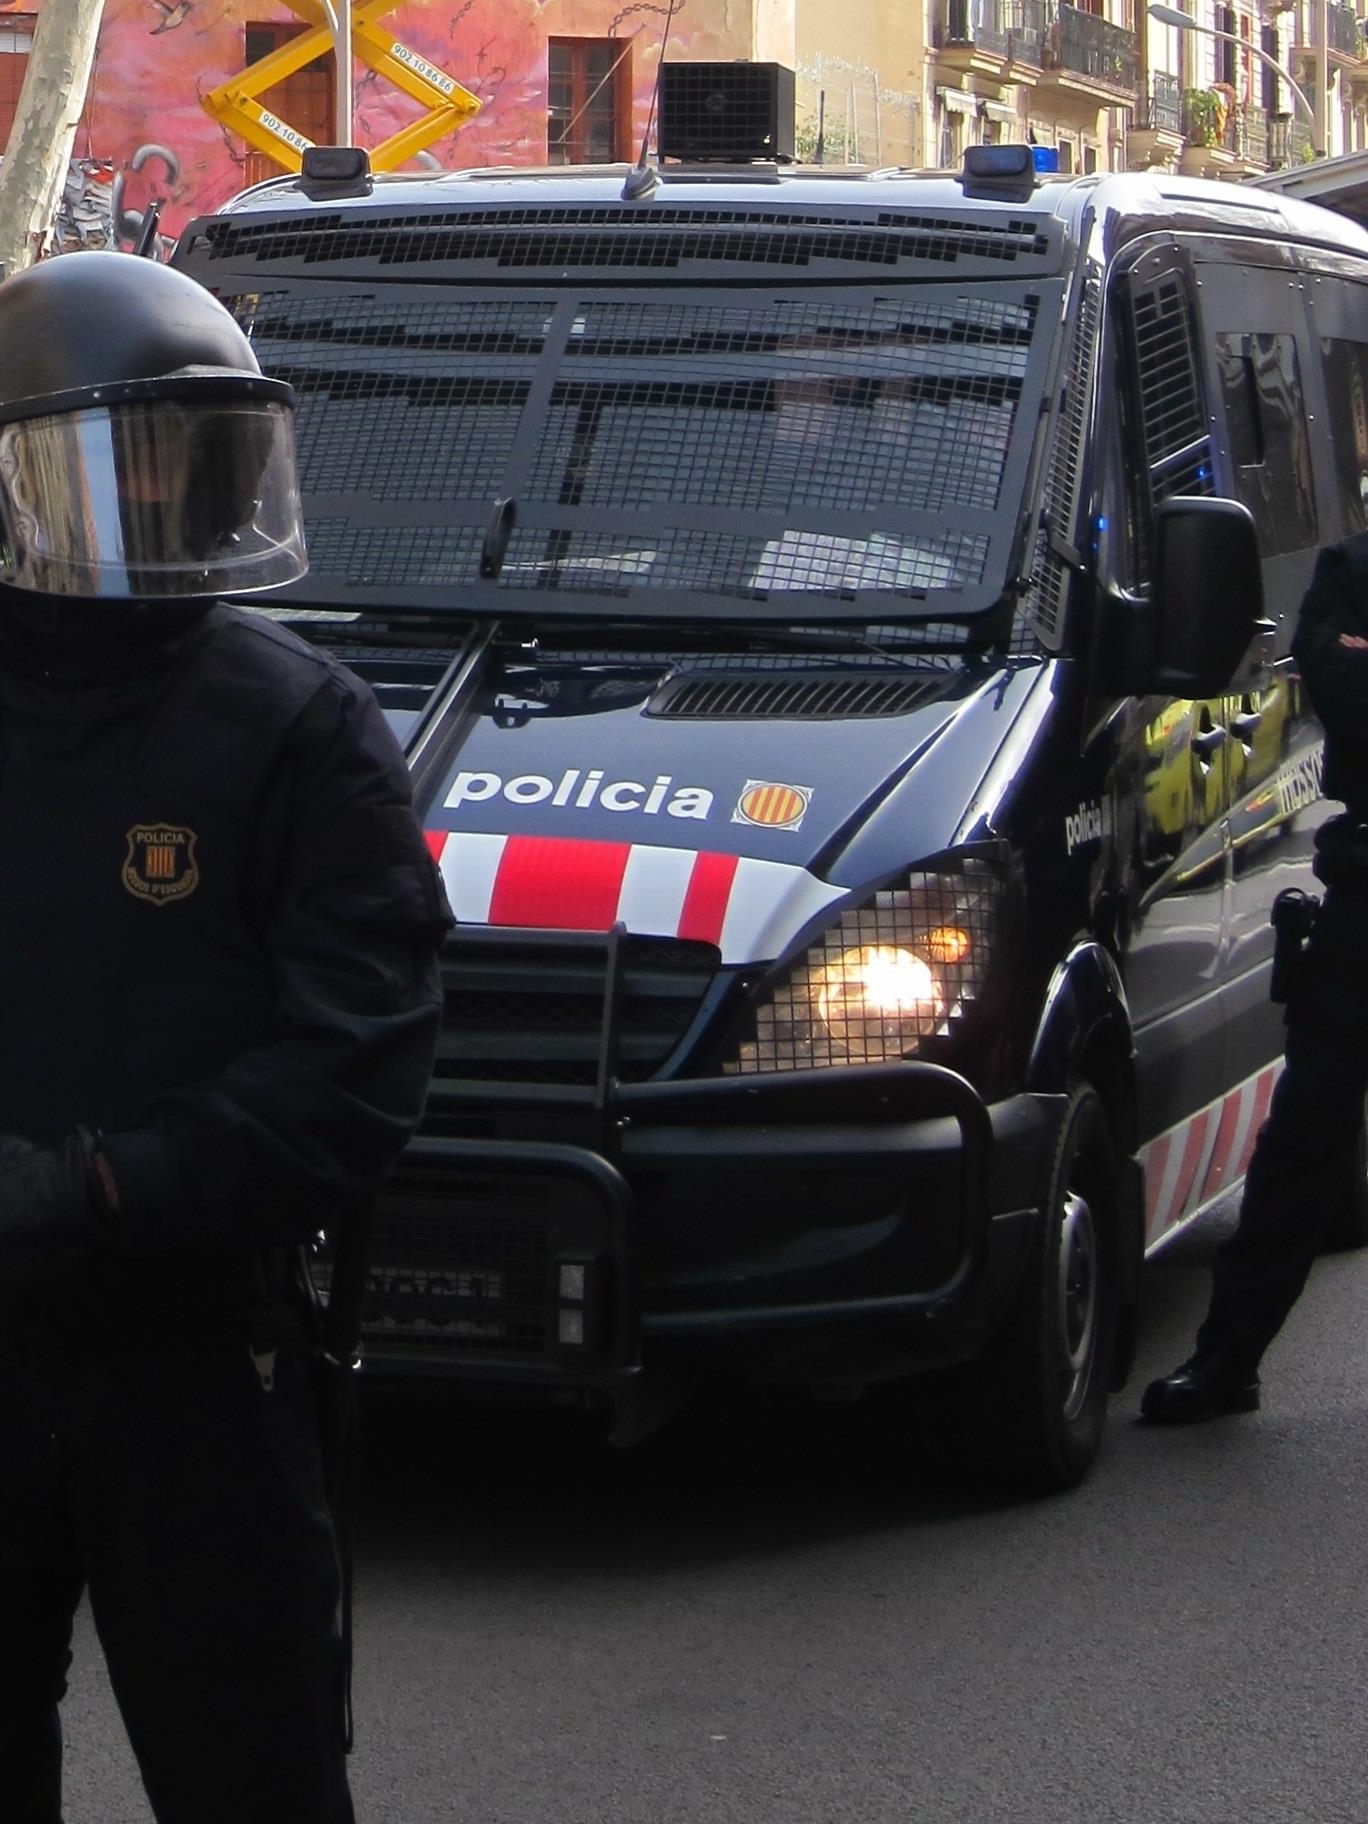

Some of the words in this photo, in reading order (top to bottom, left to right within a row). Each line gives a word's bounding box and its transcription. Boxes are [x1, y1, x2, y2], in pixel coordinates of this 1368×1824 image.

[394, 45, 413, 64] 902
[413, 60, 426, 73] 10
[425, 69, 438, 82] 86
[438, 78, 452, 92] 86
[263, 114, 281, 131] 902
[281, 128, 295, 141] 10
[443, 769, 714, 820] policia
[136, 831, 185, 844] POLICIA
[1065, 799, 1102, 856] policia
